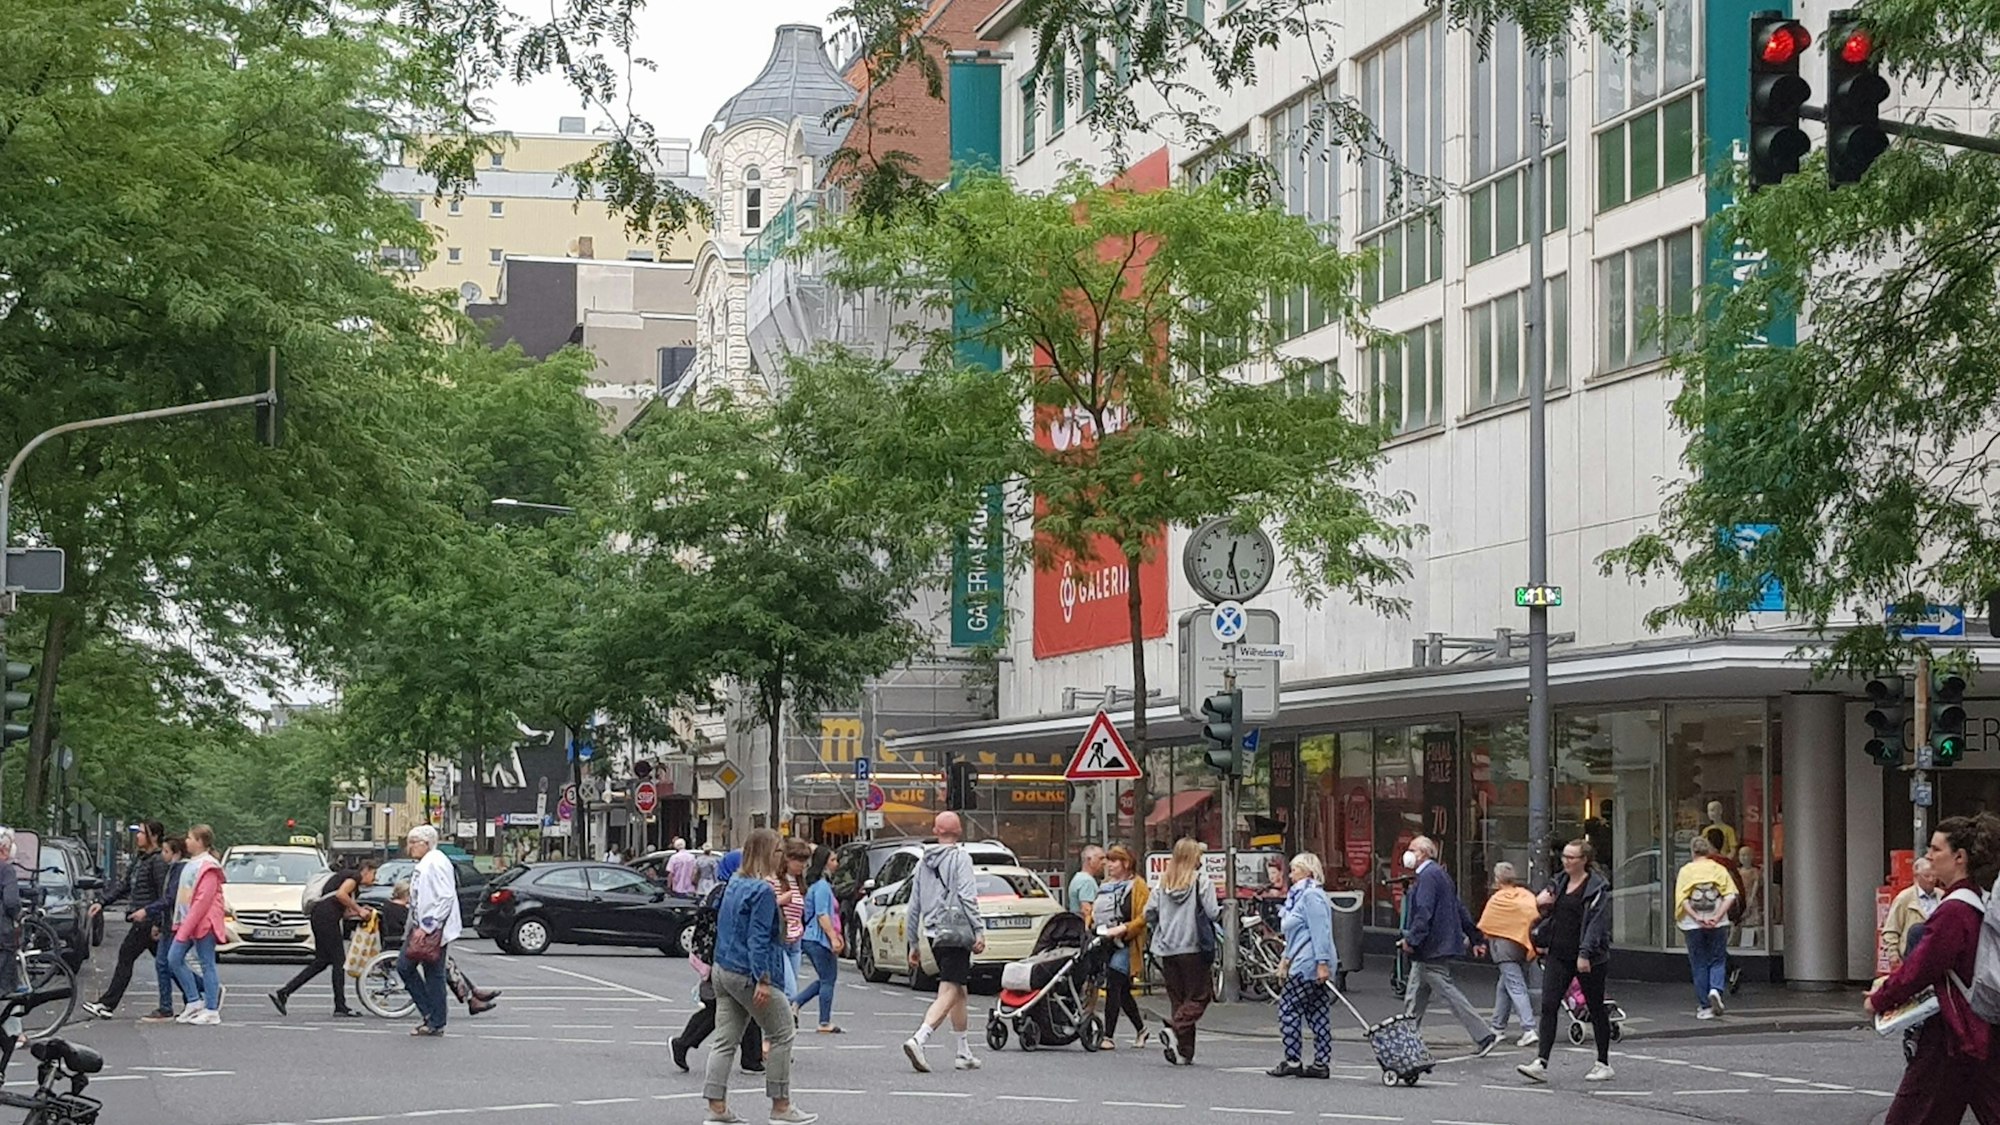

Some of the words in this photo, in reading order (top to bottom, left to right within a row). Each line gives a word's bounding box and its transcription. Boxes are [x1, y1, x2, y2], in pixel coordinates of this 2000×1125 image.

[1903, 717, 2000, 753] GER
[1426, 741, 1453, 761] FINAL
[1430, 762, 1452, 783] SALE
[638, 792, 653, 803] STOP
[1431, 805, 1448, 834] 70
